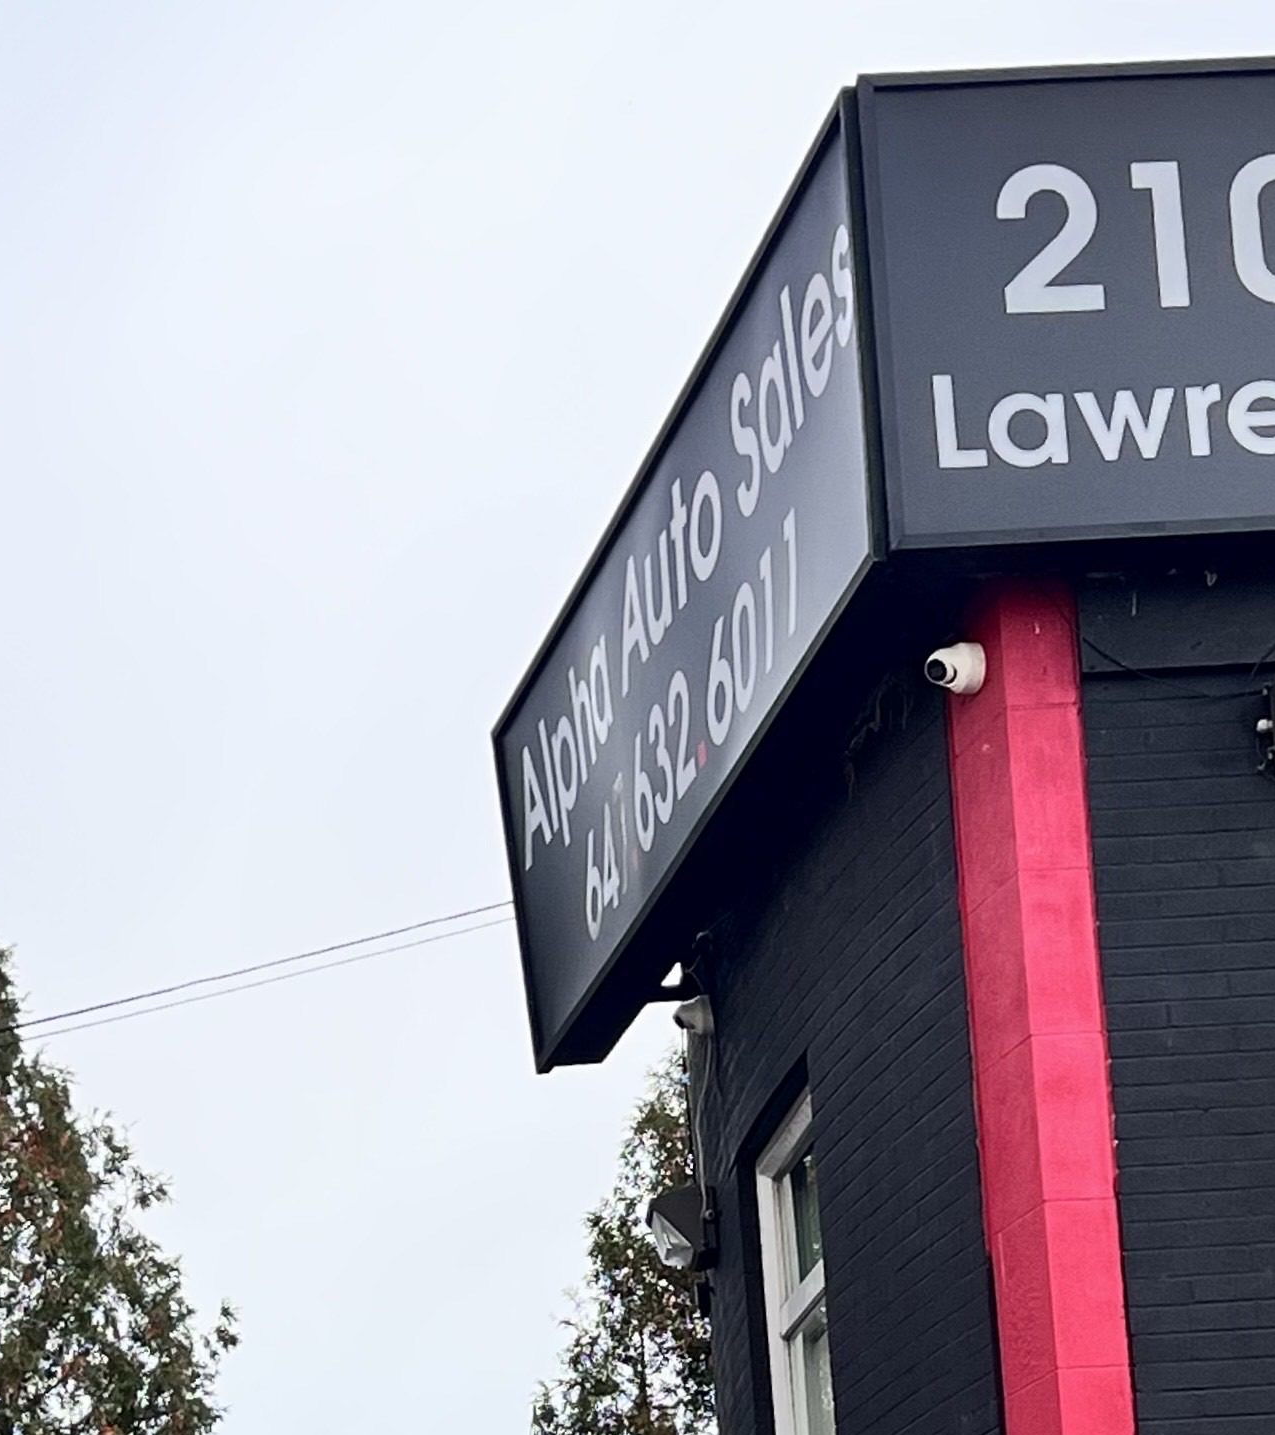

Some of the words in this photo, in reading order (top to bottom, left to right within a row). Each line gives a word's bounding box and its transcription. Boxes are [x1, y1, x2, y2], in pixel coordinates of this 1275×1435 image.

[522, 632, 613, 872] Alpha
[622, 470, 723, 699] Auto
[730, 223, 854, 518] Sales
